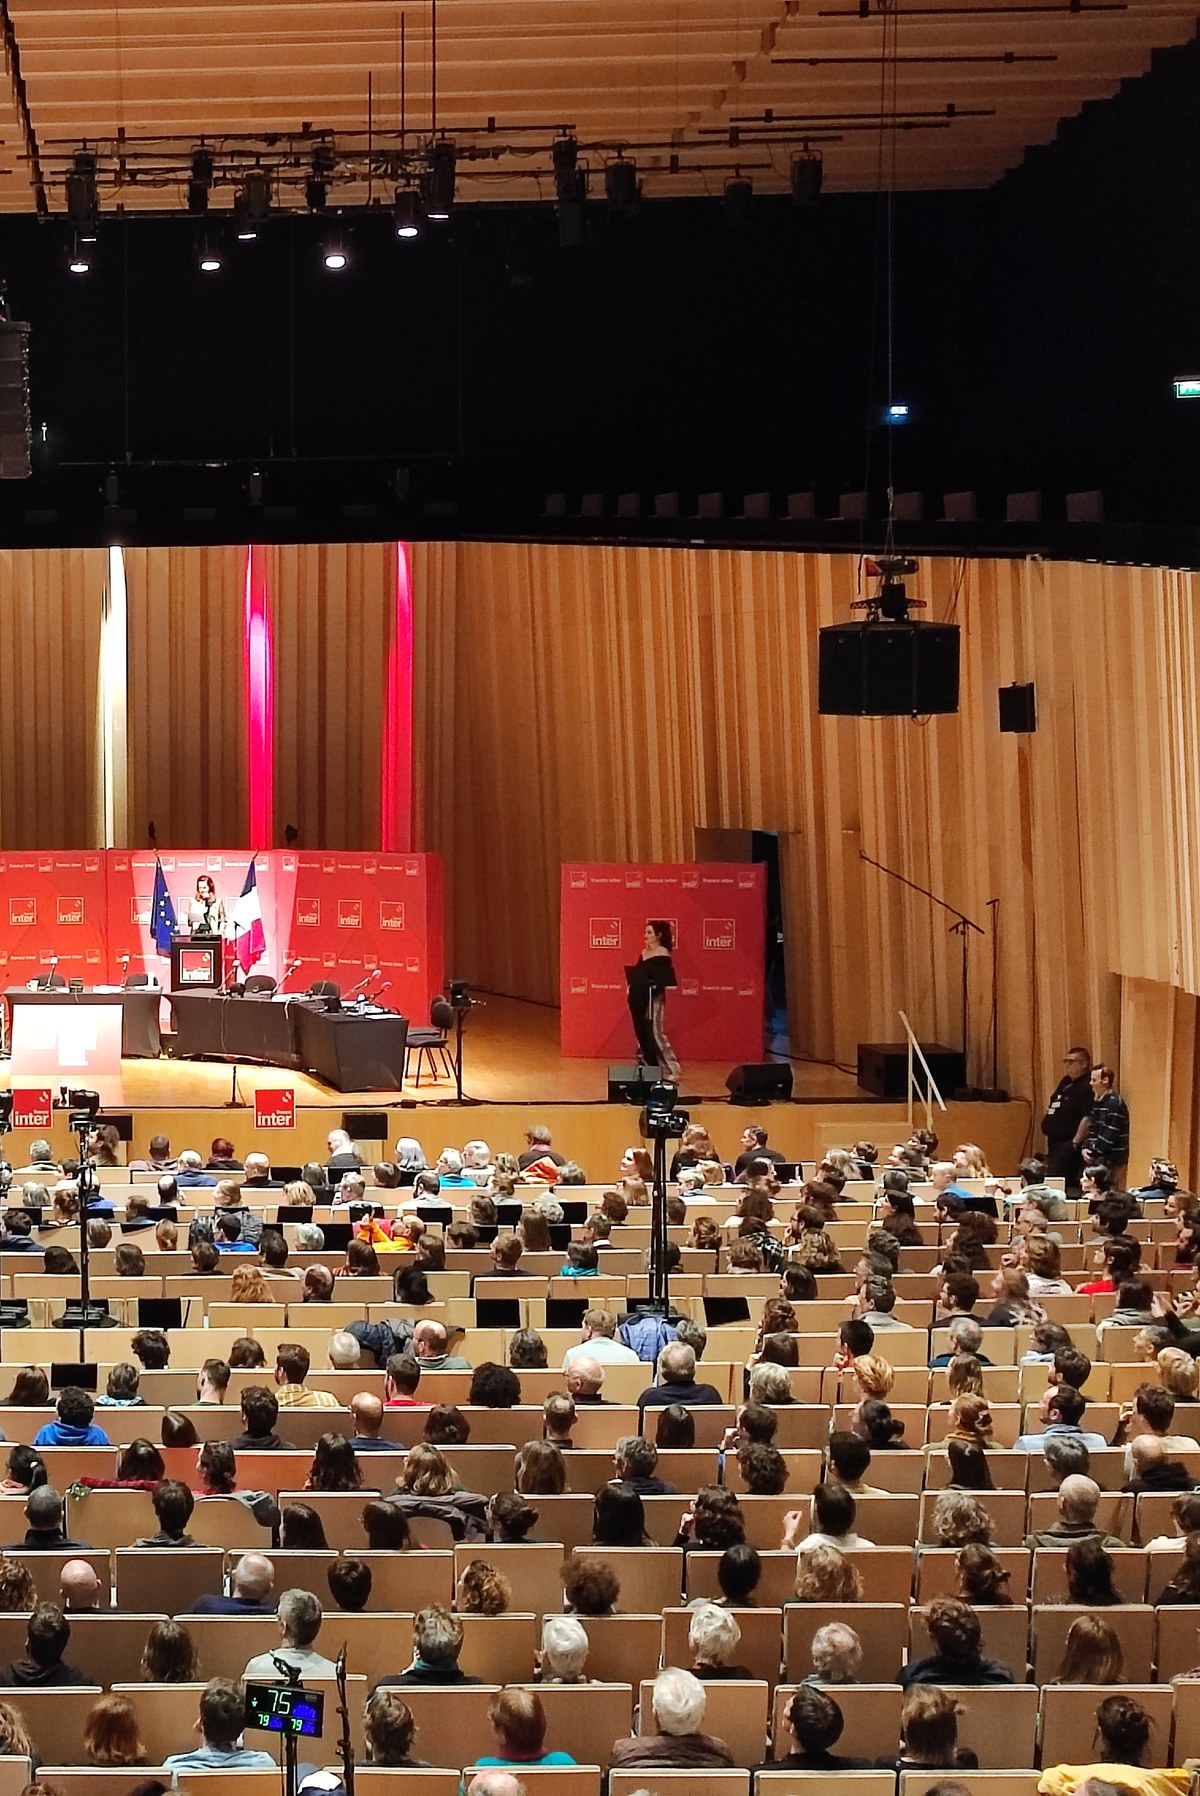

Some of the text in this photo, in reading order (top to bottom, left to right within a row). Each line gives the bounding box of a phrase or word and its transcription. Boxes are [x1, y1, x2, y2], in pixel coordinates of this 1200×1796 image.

[12, 913, 33, 923] inter
[59, 912, 81, 922] inter
[299, 913, 317, 923] inter
[340, 915, 359, 925] inter
[382, 917, 401, 927] inter
[592, 935, 618, 946] inter
[706, 937, 732, 948] inter
[15, 1111, 49, 1125] inter
[258, 1112, 292, 1126] inter
[268, 1690, 292, 1714] 75
[258, 1714, 269, 1726] 79
[291, 1718, 302, 1731] 79
